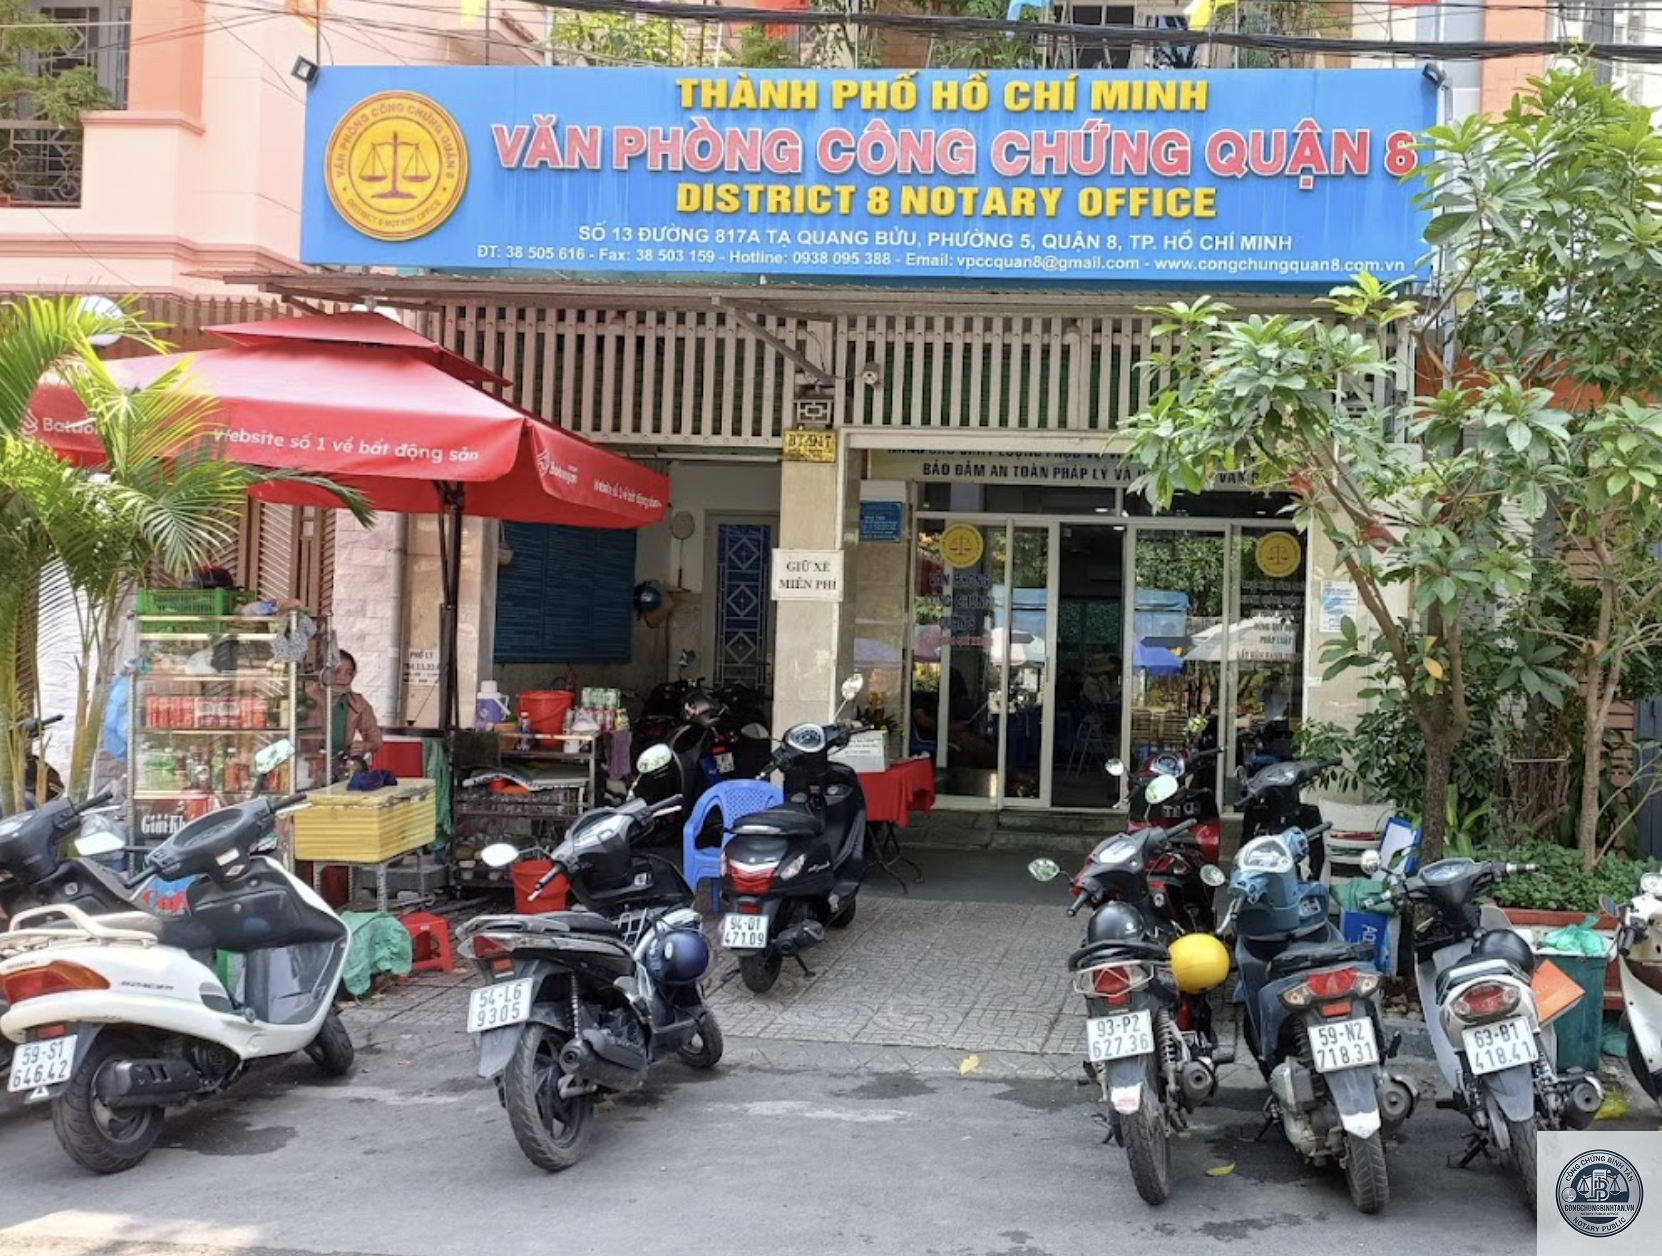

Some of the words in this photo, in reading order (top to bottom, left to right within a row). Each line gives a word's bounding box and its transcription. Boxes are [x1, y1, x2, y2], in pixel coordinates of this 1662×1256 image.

[675, 72, 818, 110] THÀNH
[831, 70, 920, 112] PHỐ
[931, 70, 990, 112] HỒ
[1003, 73, 1081, 112] CHÍ
[1090, 79, 1209, 112] MINH
[490, 113, 602, 170] VĂN
[612, 115, 803, 174] PHÒNG
[816, 118, 977, 176] CÔNG
[990, 118, 1192, 177] CHỨNG
[1204, 117, 1371, 190] QUẬN
[1383, 128, 1419, 177] 8
[675, 182, 856, 216] DISTRICT
[866, 186, 890, 215] 8
[900, 185, 1064, 217] NOTARY
[1078, 187, 1218, 218] OFFICE
[578, 221, 607, 242] SỐ
[612, 227, 633, 242] 13
[637, 223, 710, 244] ĐƯỜNG
[714, 229, 761, 244] 817A
[766, 228, 792, 249] TẠ
[796, 229, 869, 247] QUANG
[927, 226, 1014, 248] PHƯỜNG
[1019, 233, 1036, 251] 5,
[1041, 228, 1101, 252] QUẬN
[1106, 233, 1123, 252] 8,
[1129, 234, 1157, 251] TP.
[1163, 229, 1194, 251] HỒ
[1199, 230, 1236, 251] CHÍ
[1240, 235, 1293, 252] MINH
[476, 244, 502, 259] ĐT:
[505, 245, 523, 259] 38
[527, 246, 555, 260] 505
[558, 246, 586, 260] 616
[599, 247, 631, 262] Fax:
[635, 248, 653, 262] 38
[658, 248, 684, 262] 503
[689, 249, 716, 263] 159
[728, 249, 788, 265] Hotline:
[792, 252, 829, 265] 0938
[832, 252, 860, 266] 095
[864, 252, 890, 266] 388
[906, 252, 953, 267] Email:
[956, 254, 1139, 271] vpccquan8@gmail.com
[1154, 257, 1406, 274] www.congchungquan8.com.vn
[290, 431, 311, 450] số
[316, 437, 326, 450] 1
[333, 435, 354, 452] về
[358, 438, 389, 456] bất
[394, 443, 443, 463] động
[449, 446, 480, 463] sản
[922, 459, 950, 477] BẢO
[955, 460, 986, 478] ĐẢM
[990, 463, 1009, 478] AN
[1014, 462, 1049, 479] TOÀN
[1052, 463, 1088, 480] PHÁP
[1114, 465, 1132, 481] VÀ
[476, 1006, 521, 1028] 9305
[1096, 1014, 1142, 1038] 93-P2
[1092, 1032, 1150, 1059] 627.36
[1318, 1022, 1366, 1047] 59-N2
[1473, 1021, 1520, 1049] 63-B1
[22, 1040, 64, 1066] 59-S1
[1316, 1042, 1374, 1069] 718.31
[1475, 1040, 1533, 1071] 418.41
[13, 1059, 69, 1089] 646.42
